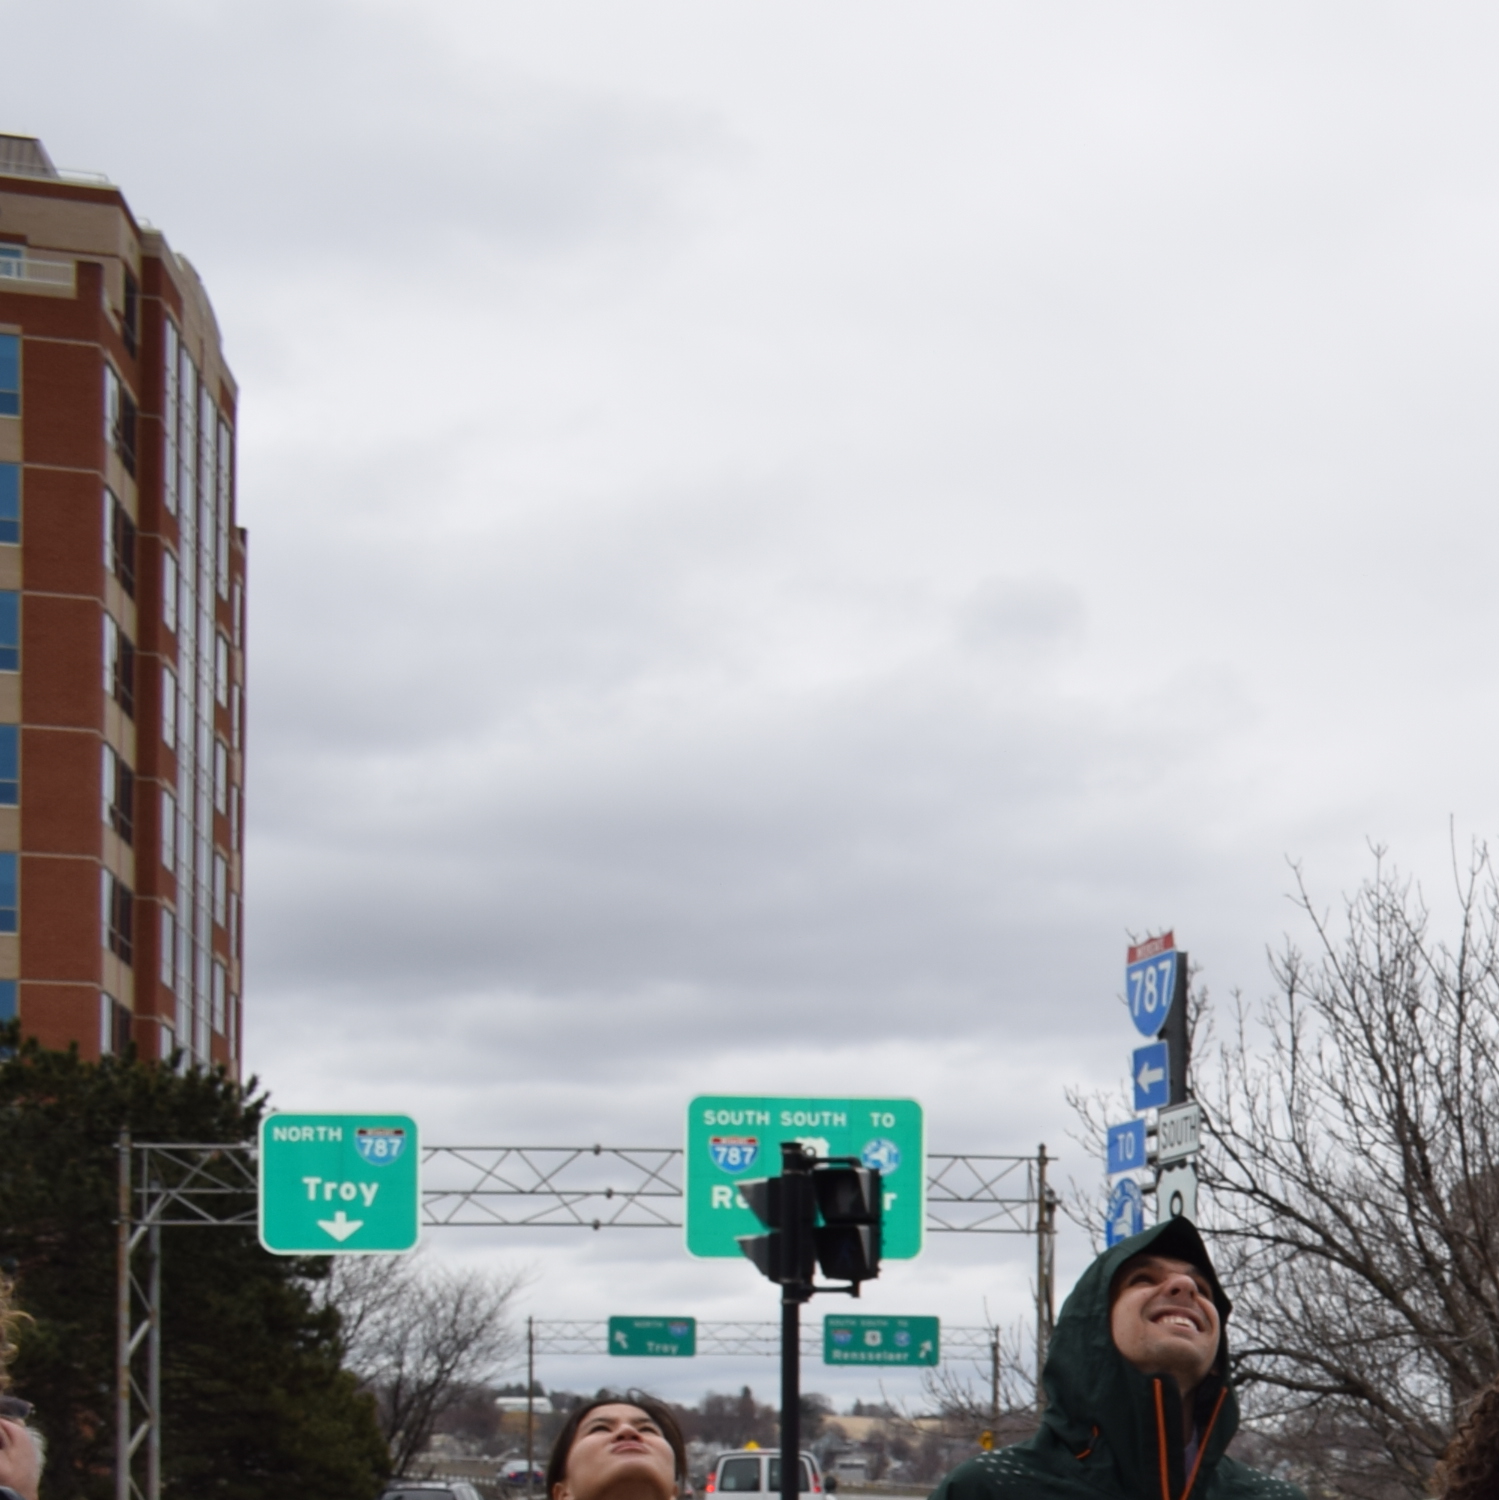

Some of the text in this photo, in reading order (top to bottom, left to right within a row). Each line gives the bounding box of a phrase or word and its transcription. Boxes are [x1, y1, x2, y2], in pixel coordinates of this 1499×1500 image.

[1130, 959, 1172, 1017] 787
[704, 1109, 896, 1128] SOUTH SOUTH TO
[1161, 1112, 1198, 1150] SOUTH
[272, 1126, 402, 1158] NORTH 787
[714, 1146, 755, 1166] 787
[1116, 1130, 1135, 1163] TO
[302, 1176, 379, 1207] Troy
[646, 1341, 679, 1356] Troy
[832, 1348, 910, 1361] Rensselaer
